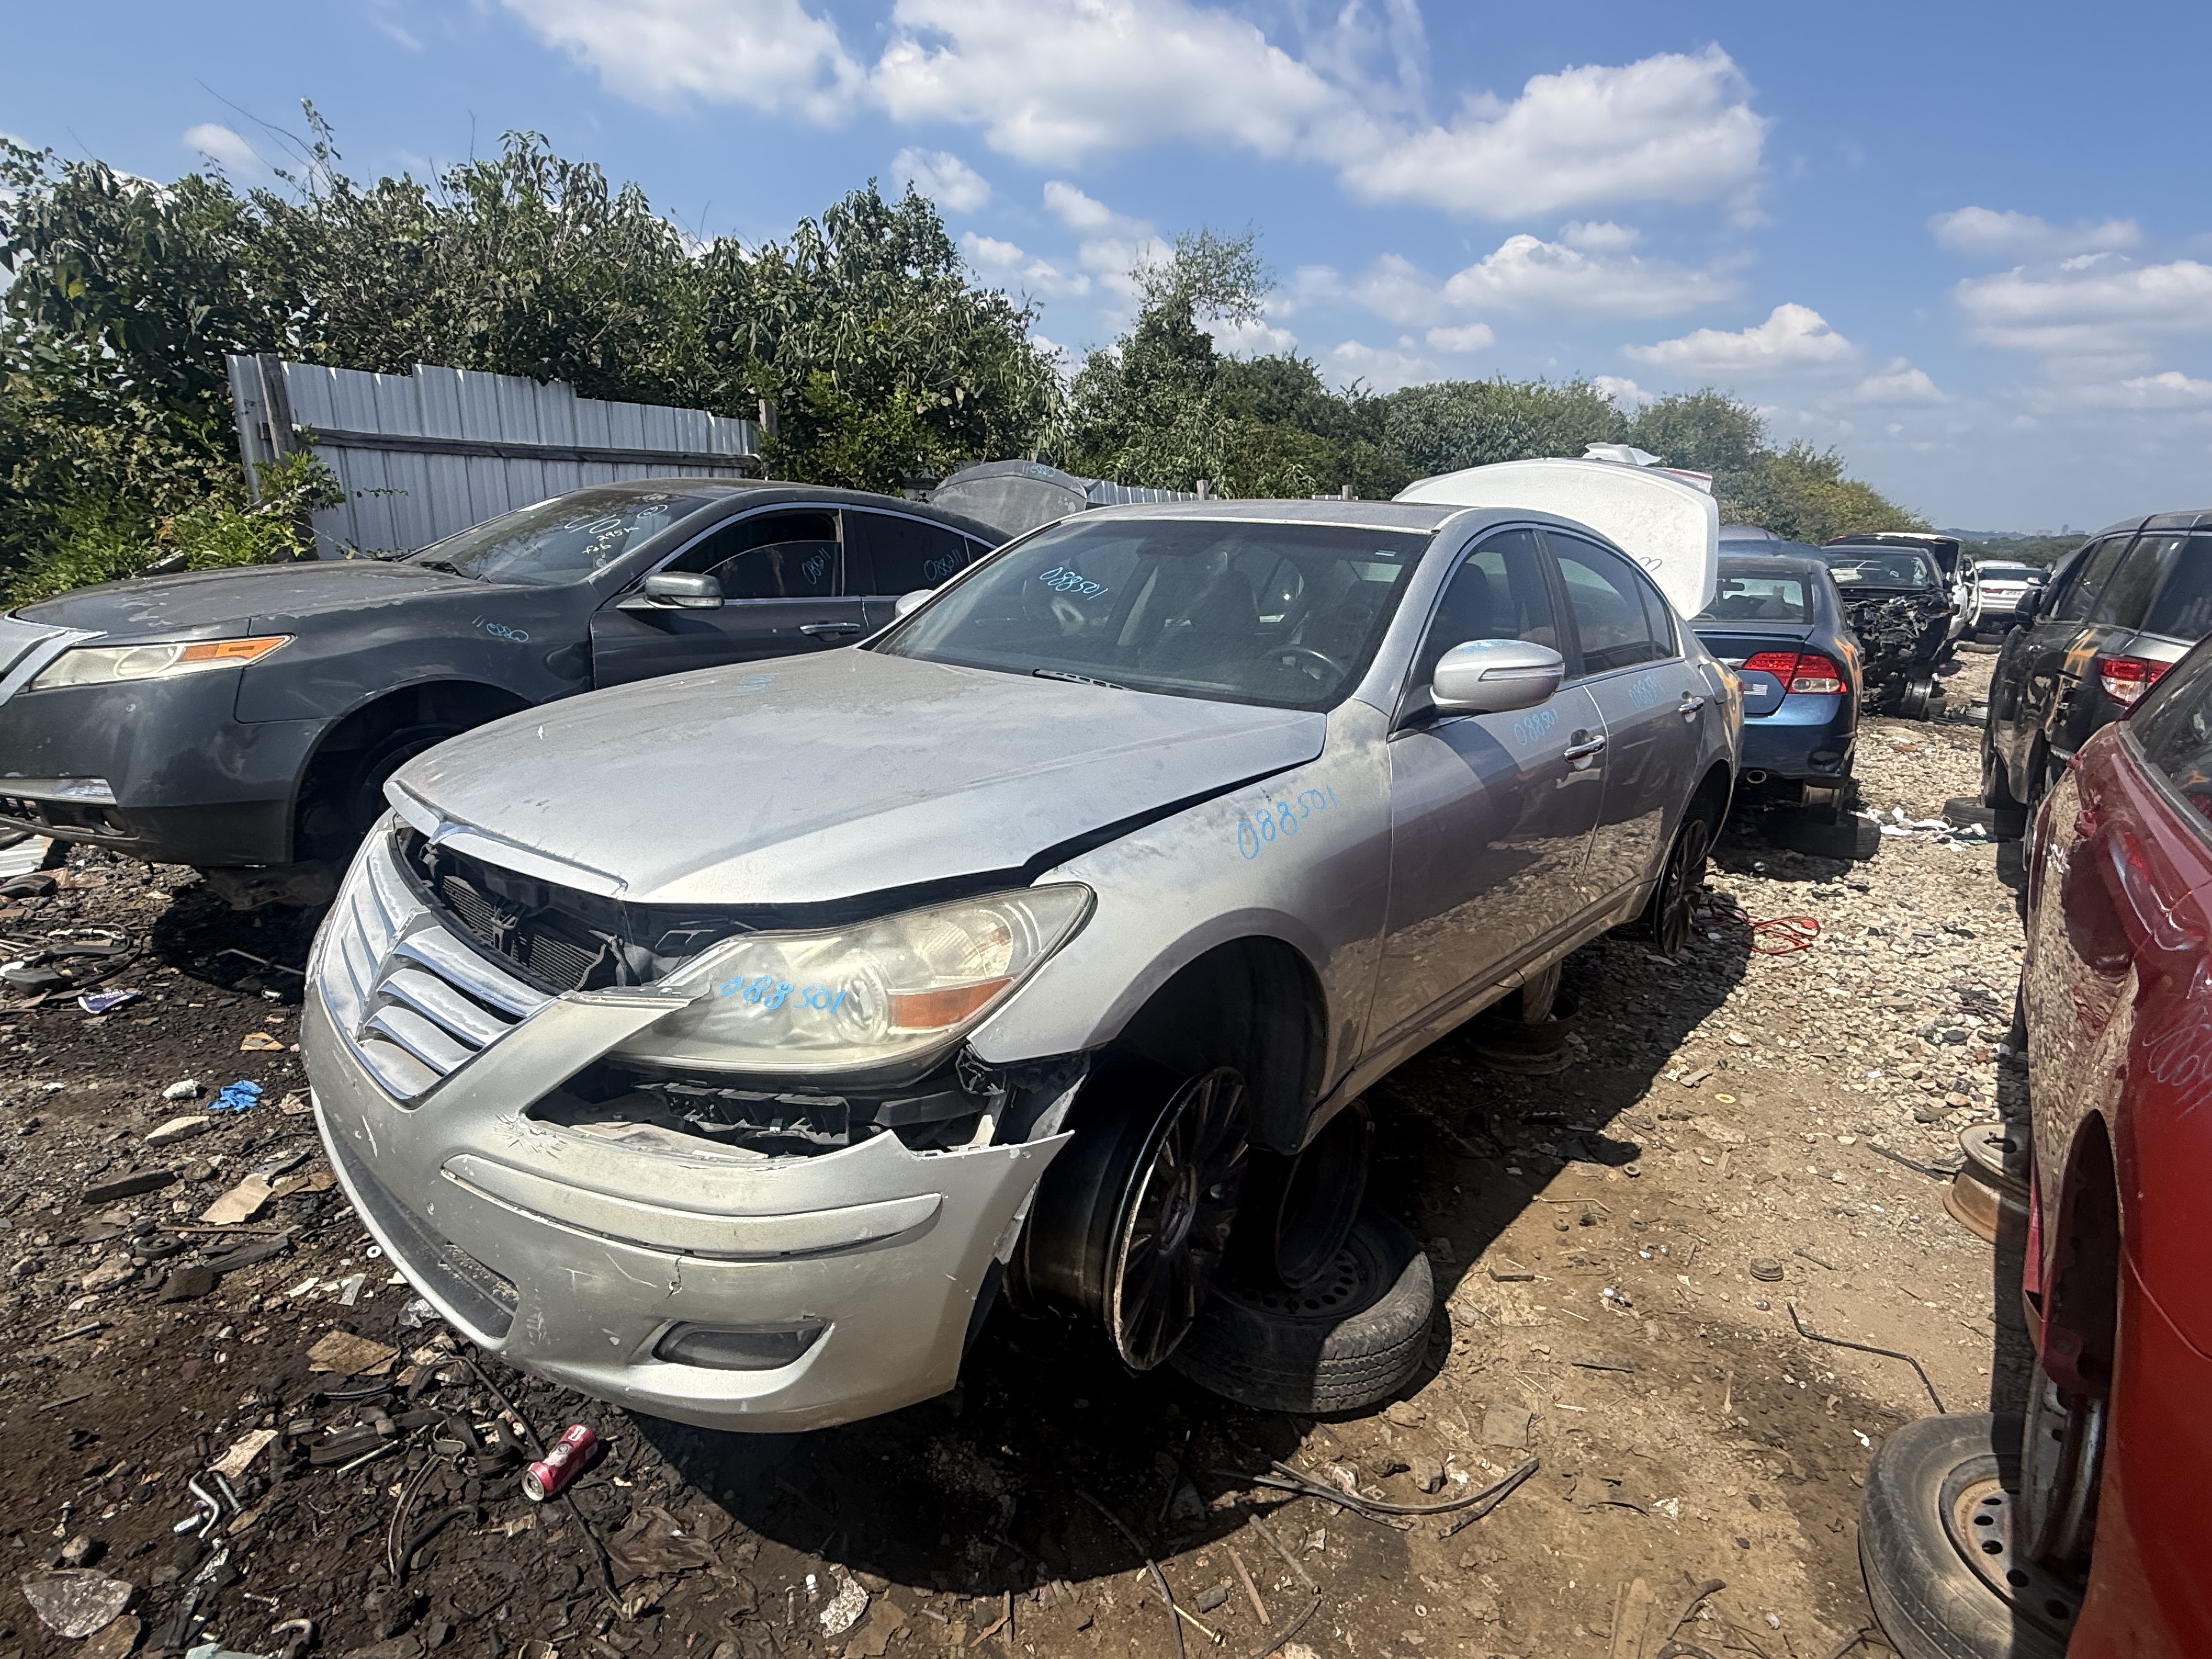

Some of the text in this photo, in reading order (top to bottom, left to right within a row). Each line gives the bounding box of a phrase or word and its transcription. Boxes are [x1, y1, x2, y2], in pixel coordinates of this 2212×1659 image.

[1040, 567, 1108, 600] 088501
[1238, 783, 1338, 860] 088501
[719, 974, 847, 1015] 088501
